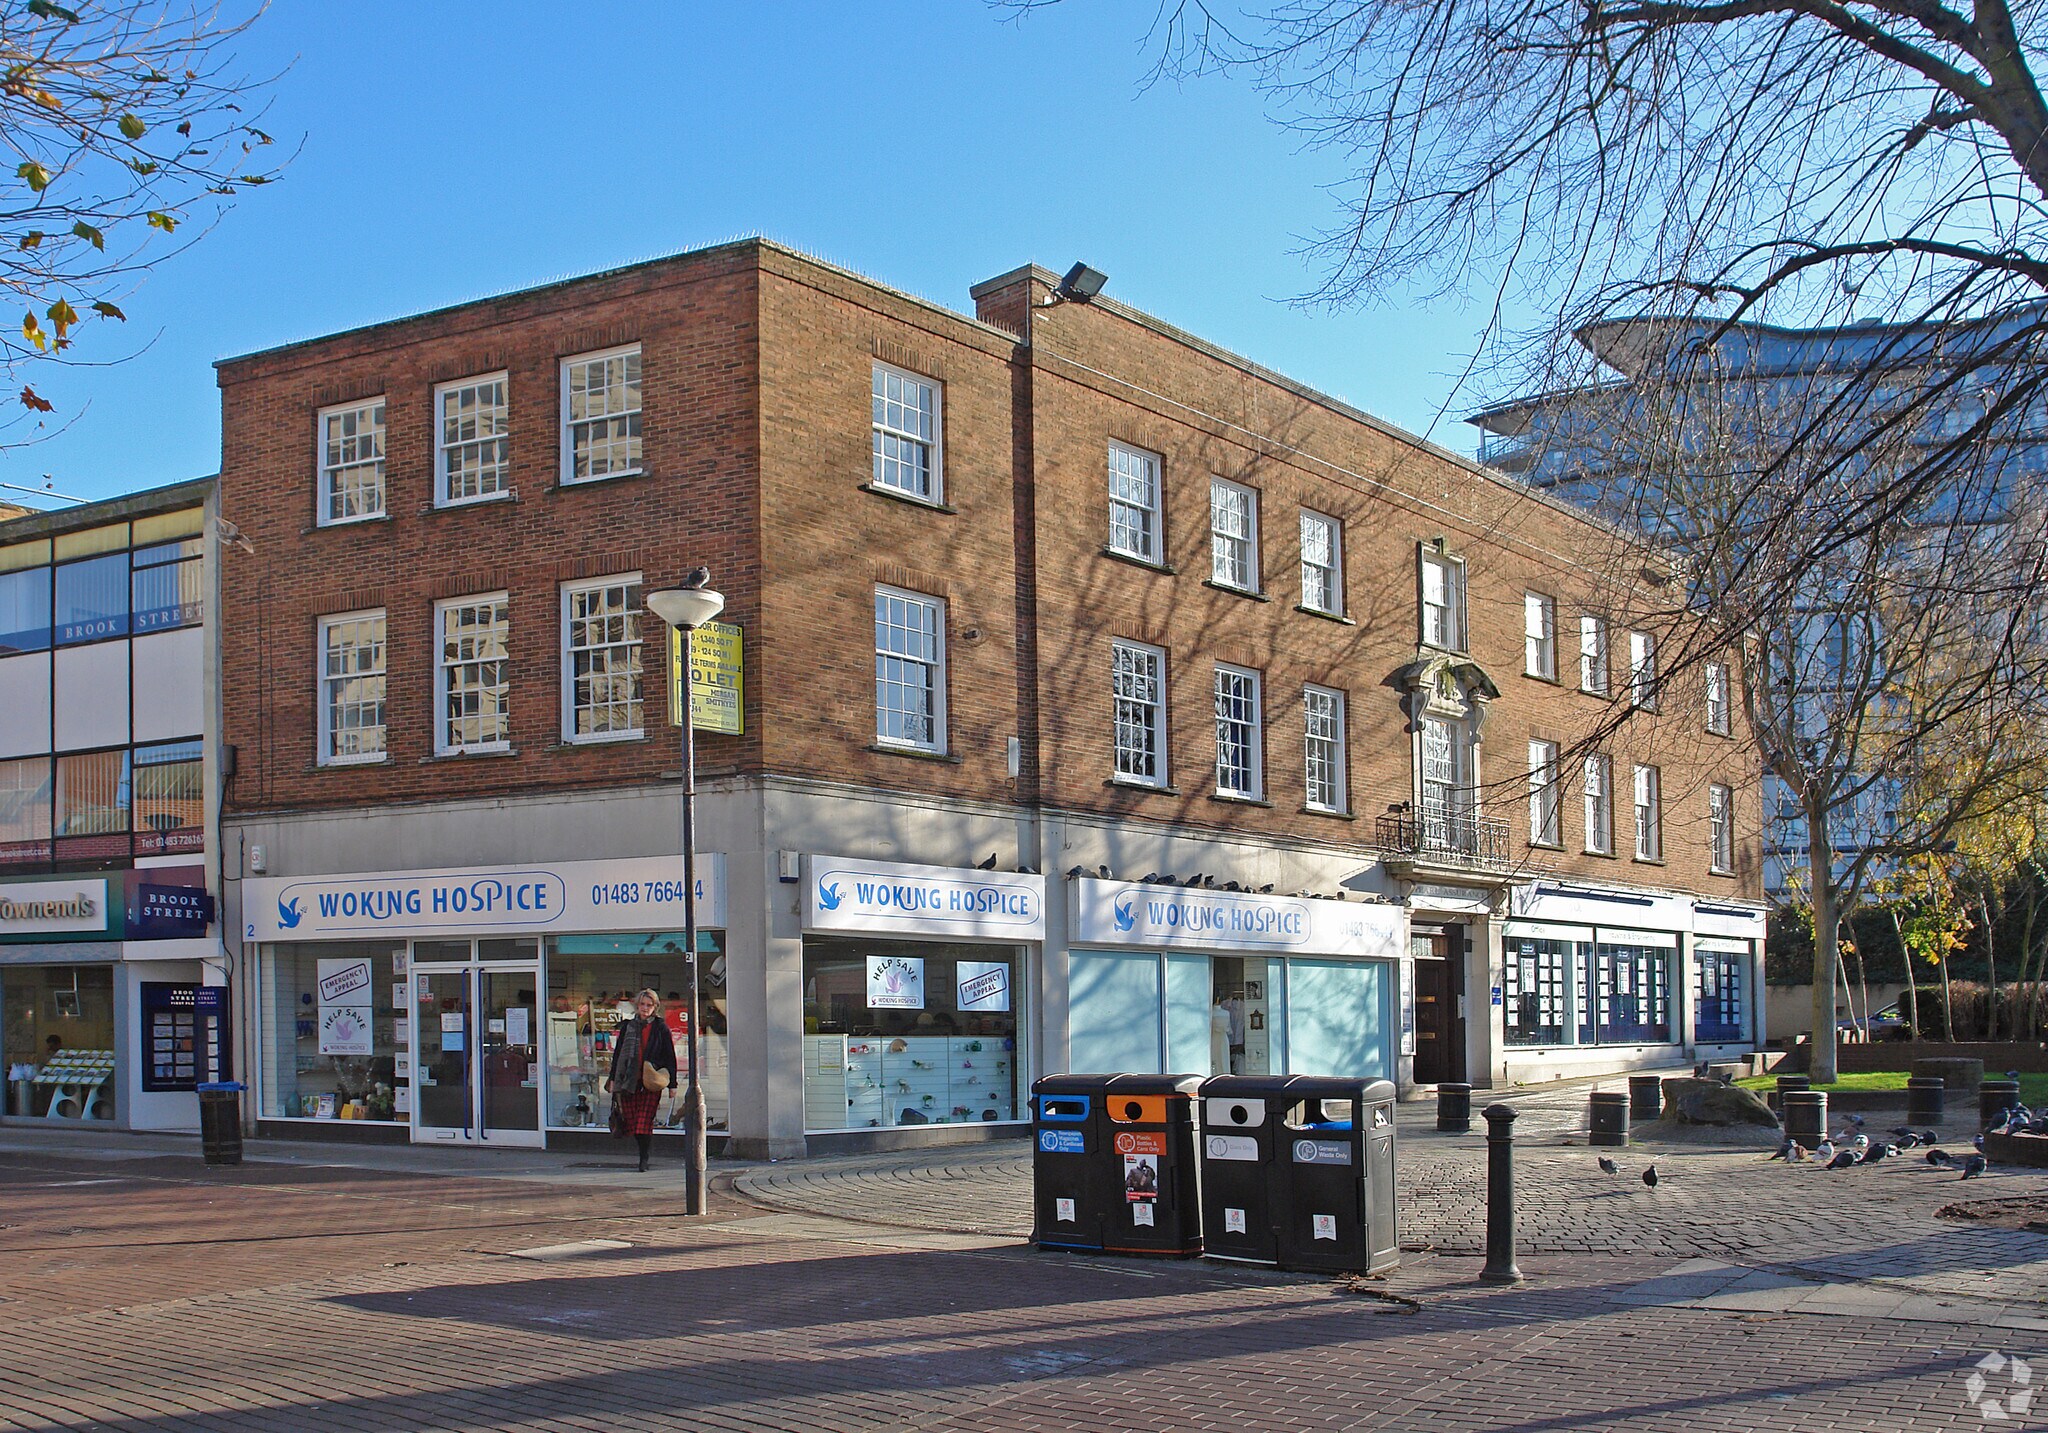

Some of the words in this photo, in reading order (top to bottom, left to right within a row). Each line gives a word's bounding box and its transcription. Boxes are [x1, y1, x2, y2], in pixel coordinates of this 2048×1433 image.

[66, 620, 116, 639] BROOK
[139, 605, 203, 627] STREET
[713, 624, 740, 637] OFFICES
[706, 671, 736, 687] LET
[149, 894, 199, 906] BROOK
[318, 888, 421, 920] WOKING
[433, 880, 547, 913] HOSPICE
[592, 882, 640, 905] 01483
[645, 880, 704, 903] 76644
[856, 882, 941, 911] WOKING
[950, 888, 1029, 915] HOSPICE
[144, 907, 204, 919] STREET
[1149, 901, 1224, 931] WOKING
[1231, 906, 1301, 934] HOSPICE
[247, 924, 254, 937] 2
[325, 968, 363, 989] EMERGENCY
[873, 958, 893, 981] HELP
[896, 958, 918, 983] SAVE
[334, 979, 358, 993] APPEAL
[964, 973, 1001, 993] EMERGENCY
[972, 984, 997, 998] APPEAL
[324, 1009, 342, 1030] HELP
[345, 1008, 366, 1031] SAVE
[1336, 1152, 1348, 1160] Only
